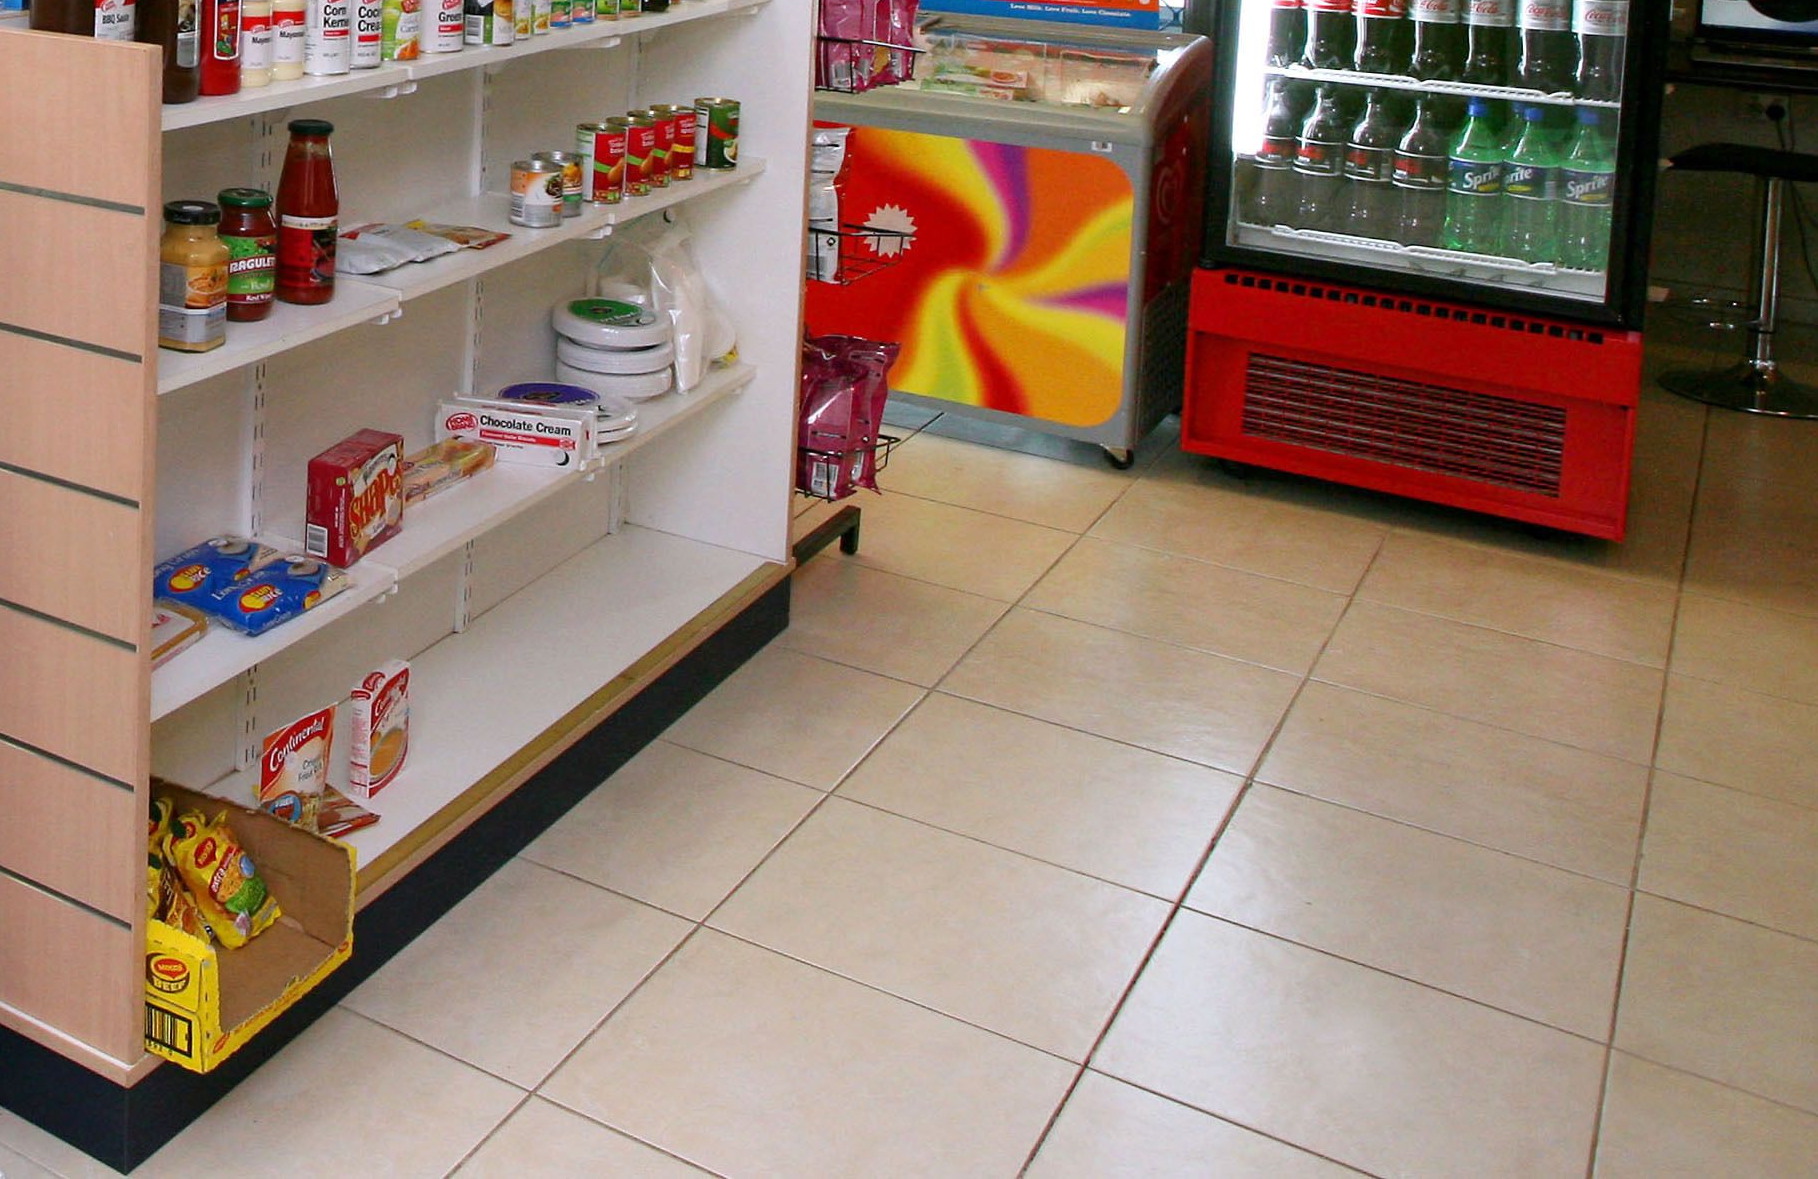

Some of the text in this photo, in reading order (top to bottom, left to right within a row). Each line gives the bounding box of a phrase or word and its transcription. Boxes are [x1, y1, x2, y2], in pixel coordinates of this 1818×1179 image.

[102, 14, 116, 24] BBQ
[480, 415, 572, 436] Chocolate Cream
[269, 717, 325, 772] Continental
